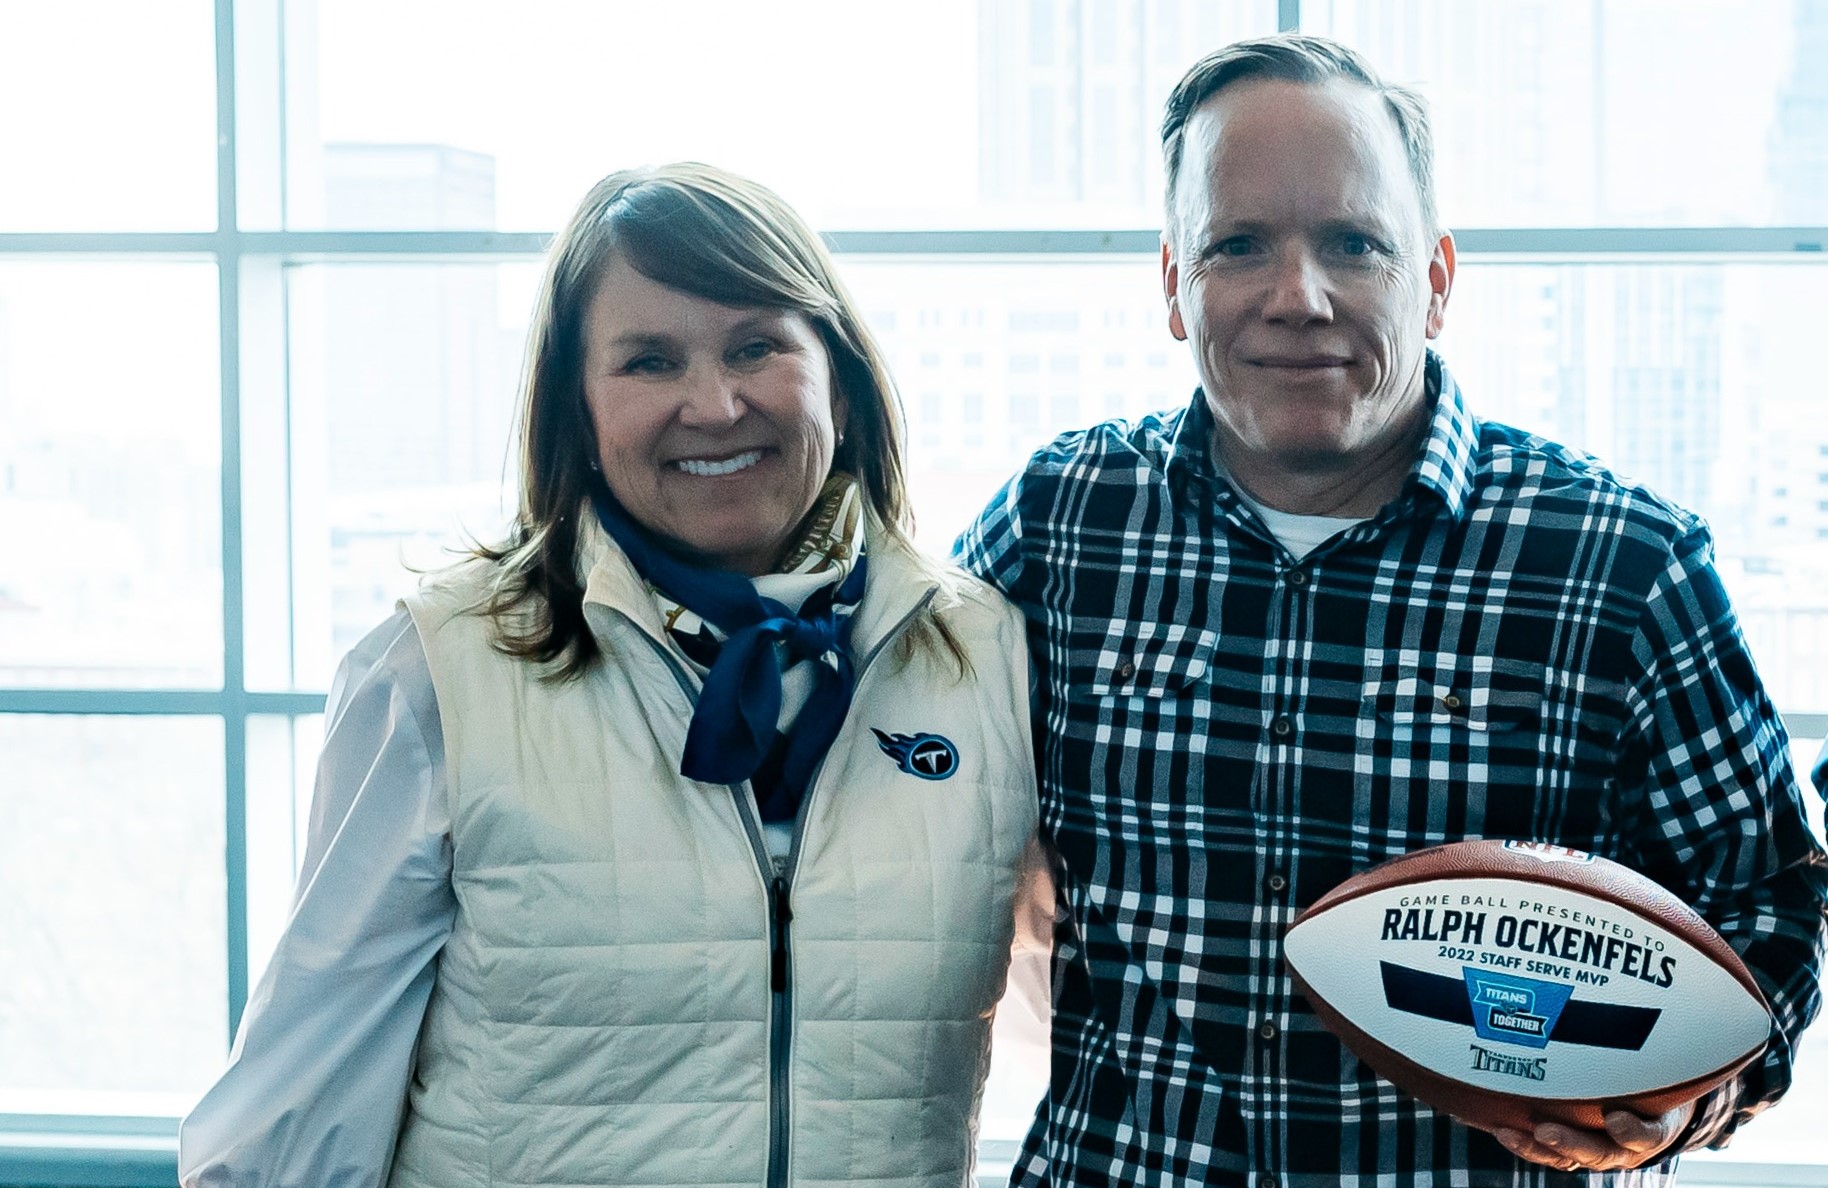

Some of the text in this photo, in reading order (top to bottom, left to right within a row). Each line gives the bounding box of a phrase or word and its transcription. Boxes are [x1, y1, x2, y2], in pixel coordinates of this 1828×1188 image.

[1400, 895, 1665, 952] GAME BALL PRESENTED TO
[1380, 908, 1677, 989] RALPH OCKENFELS
[1438, 946, 1610, 987] 2022 STAFF SERVE MVP
[1486, 987, 1527, 1004] TITANS
[1493, 1013, 1540, 1031] TOGETHER
[1470, 1044, 1547, 1081] TITANS
